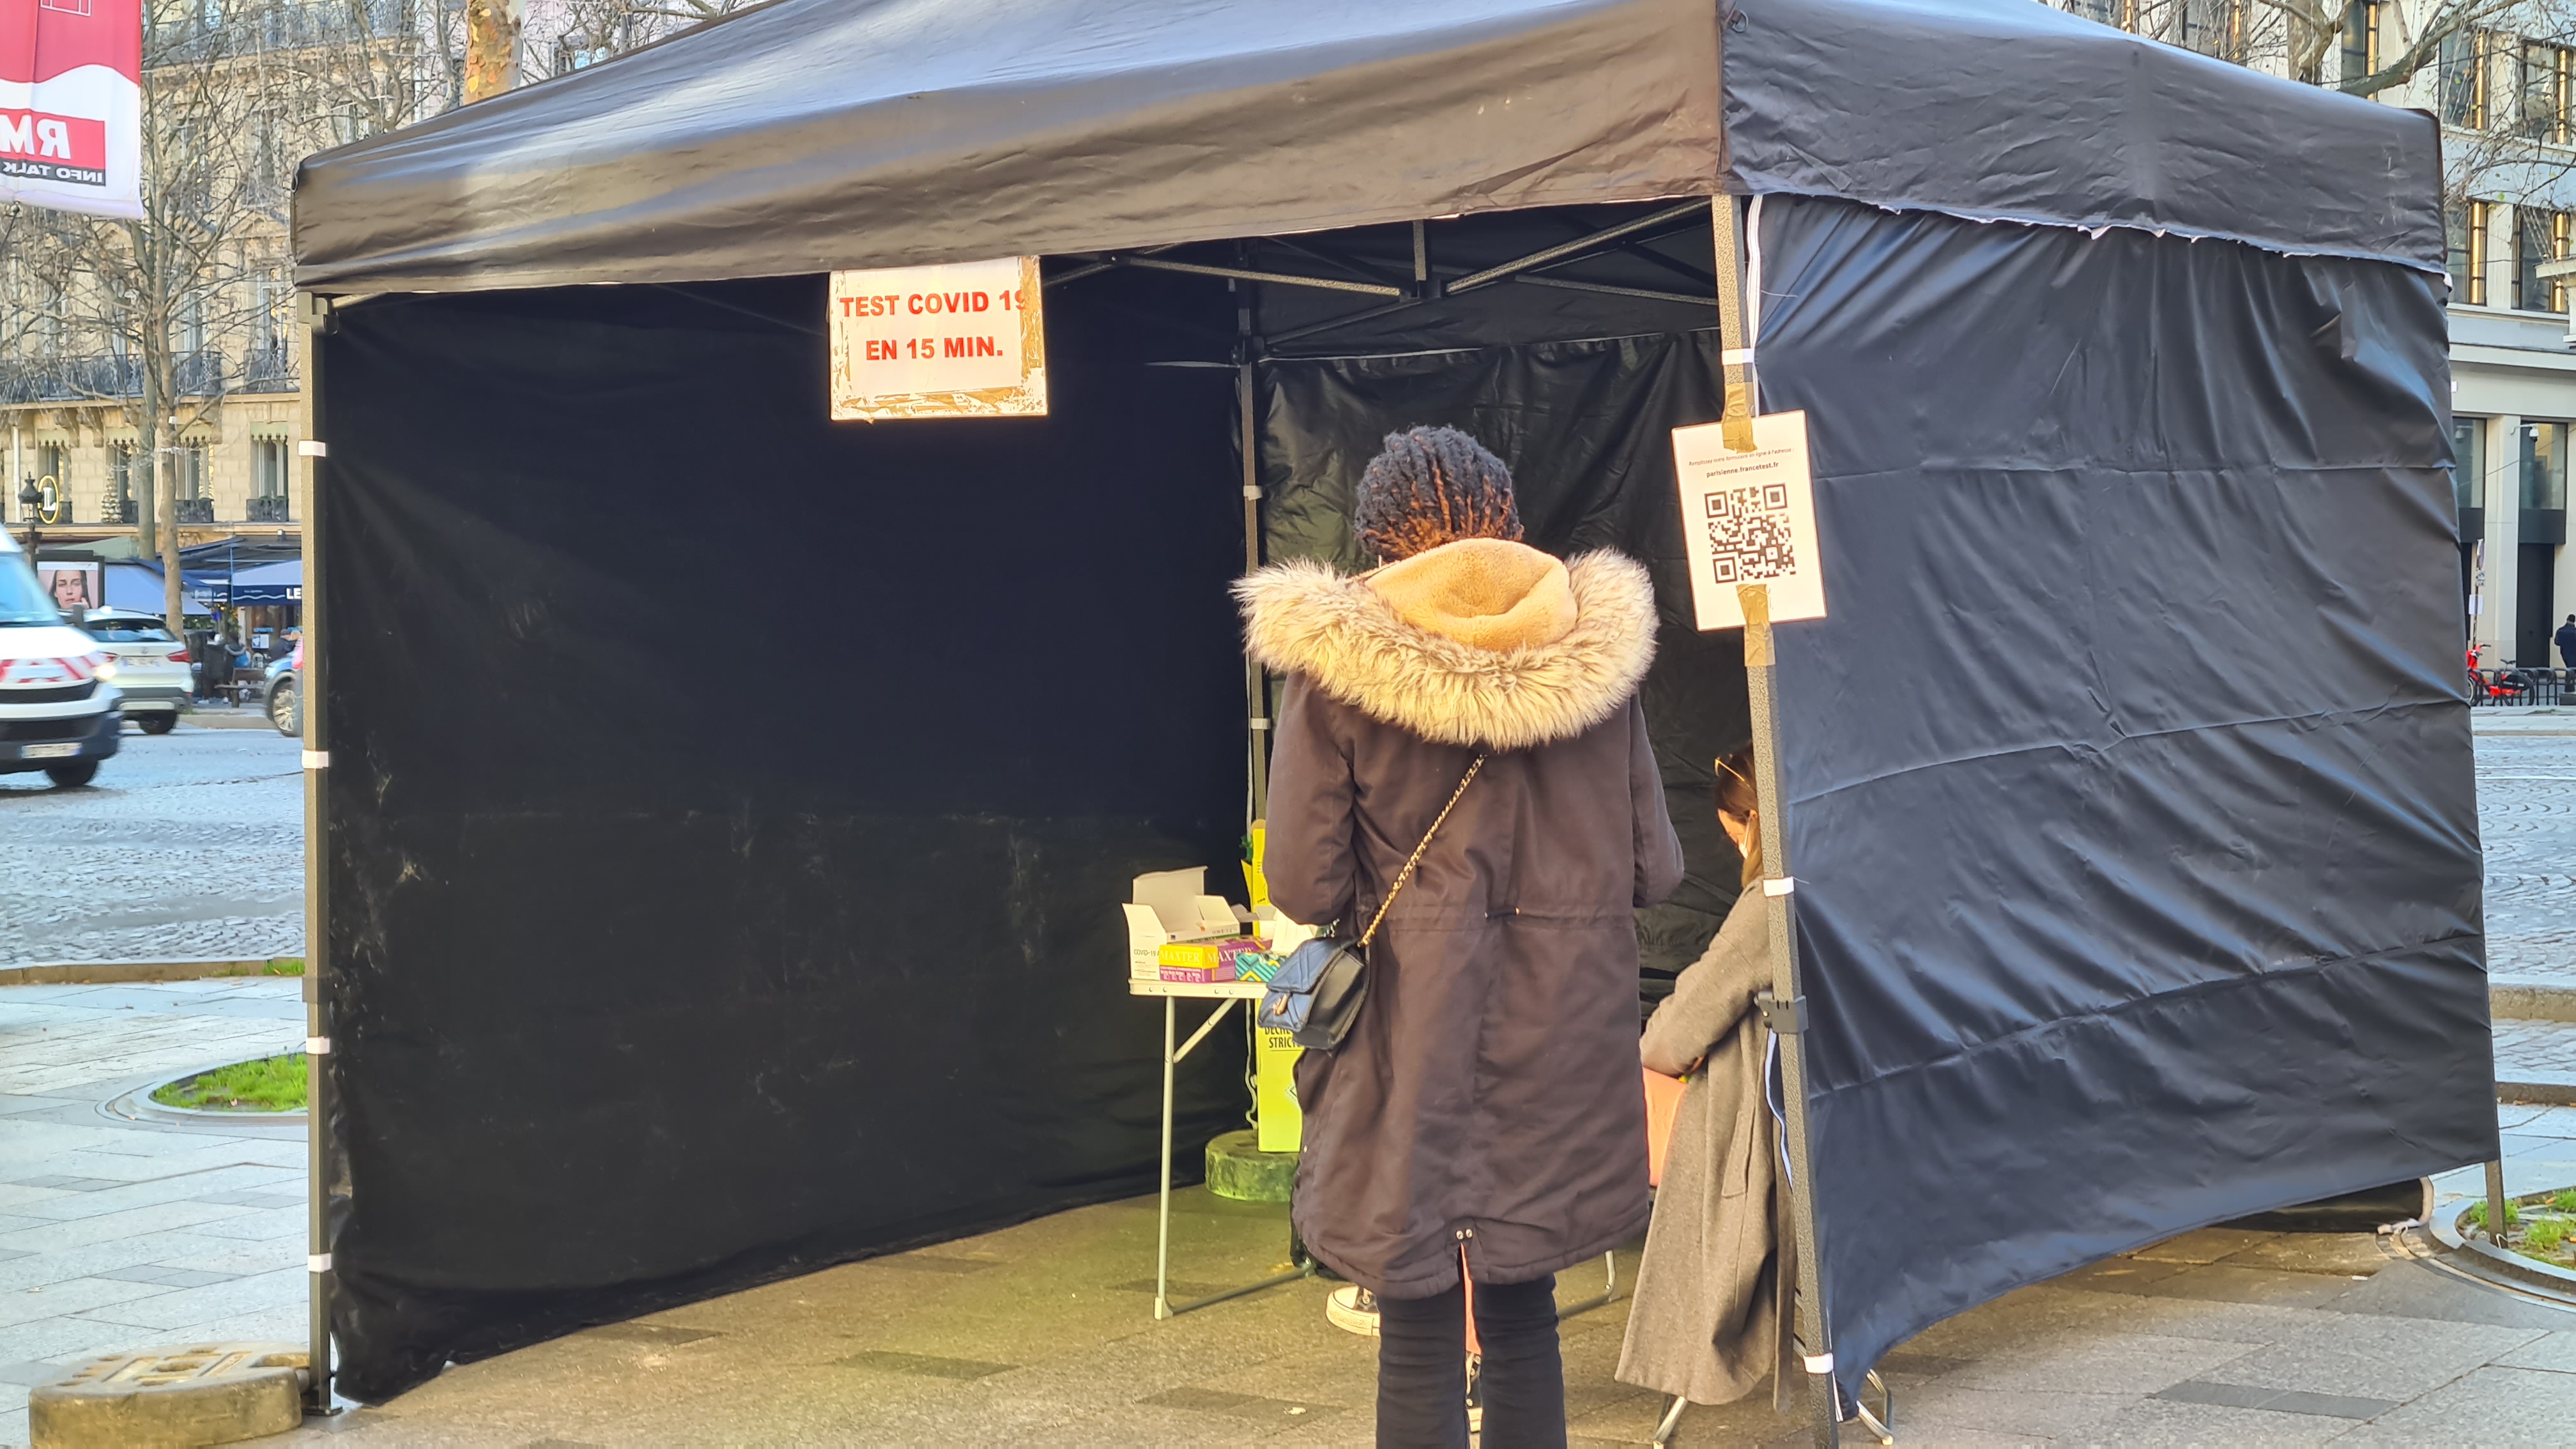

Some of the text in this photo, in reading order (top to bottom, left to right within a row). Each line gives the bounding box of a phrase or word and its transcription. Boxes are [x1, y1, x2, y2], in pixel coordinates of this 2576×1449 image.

[839, 295, 900, 318] TEST
[907, 291, 989, 315] COVID
[866, 335, 1003, 360] EN 15 MIN.
[1706, 461, 1779, 479] parisienne.francetest.fr
[1160, 950, 1200, 963] MAXTER
[1269, 1037, 1301, 1048] STRIC
